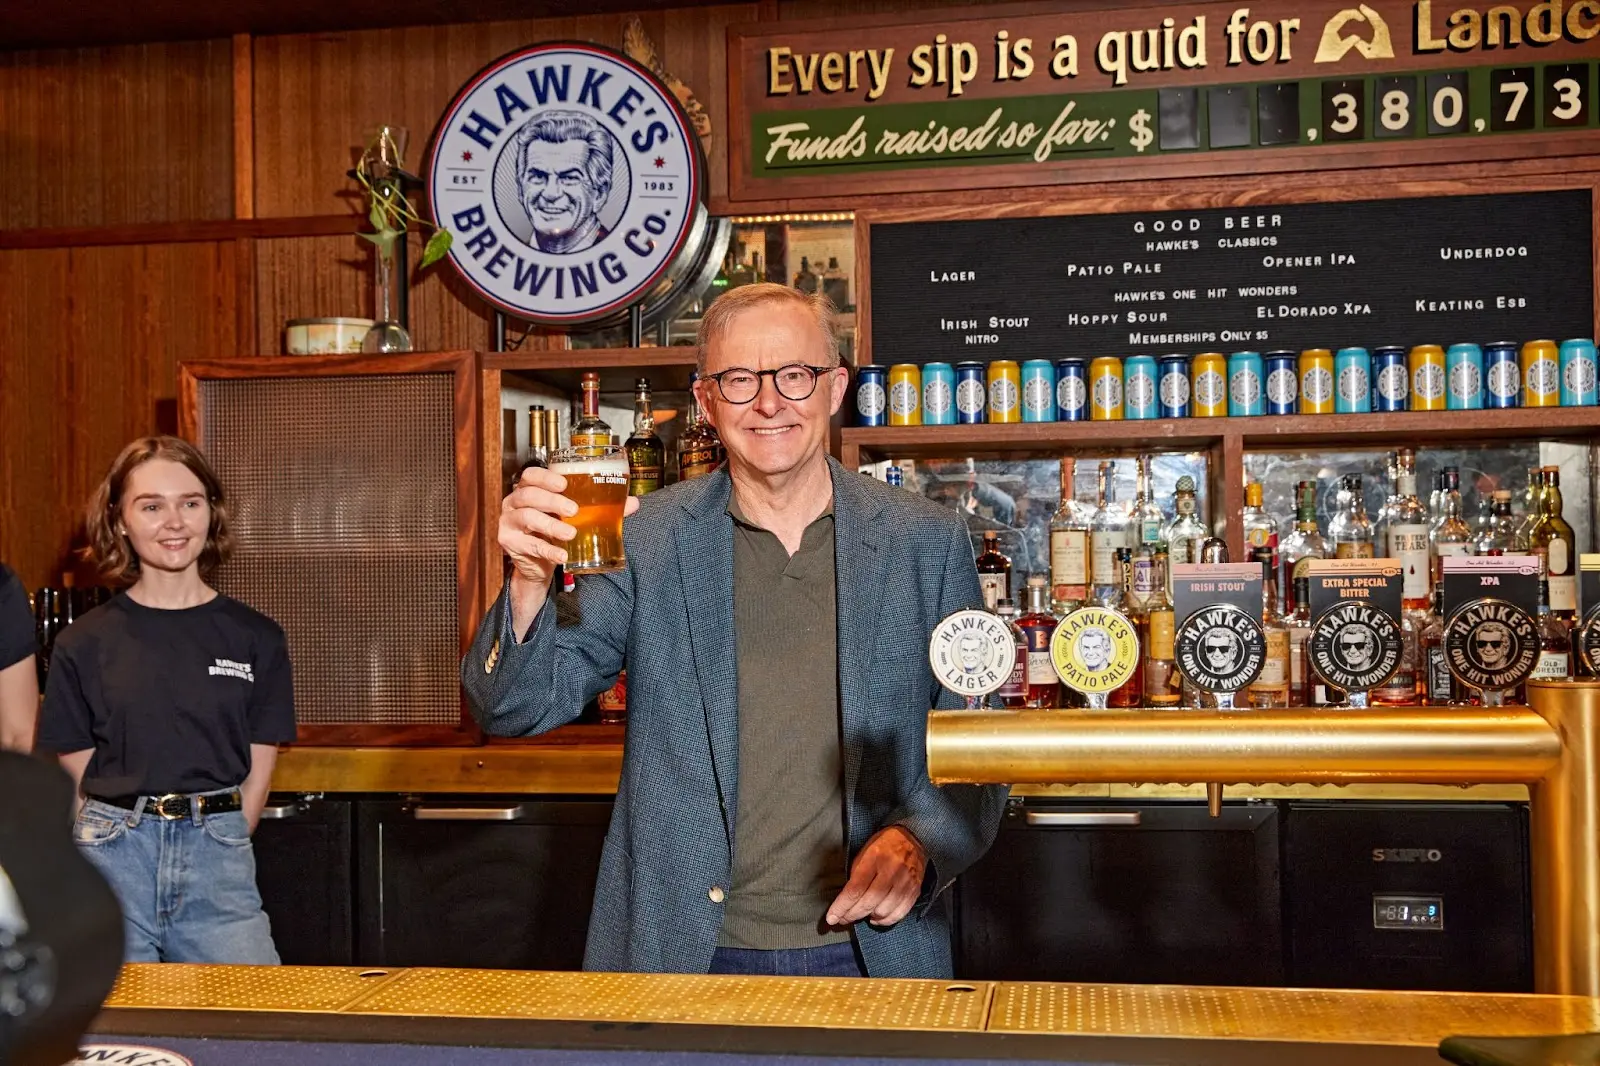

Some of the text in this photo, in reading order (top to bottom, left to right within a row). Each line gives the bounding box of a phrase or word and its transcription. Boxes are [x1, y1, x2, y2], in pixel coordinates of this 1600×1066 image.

[767, 46, 895, 99] Every
[909, 33, 978, 95] sip
[997, 30, 1035, 80] is
[1053, 34, 1079, 77] a
[1098, 15, 1207, 85] quid
[1227, 8, 1300, 64] for
[460, 65, 668, 153] HAWKE'S
[766, 116, 867, 163] Funds
[875, 107, 1003, 155] raised
[998, 118, 1041, 148] so
[1031, 101, 1115, 162] far:
[452, 175, 477, 185] EST
[644, 182, 674, 192] 1983
[1134, 215, 1282, 233] GOOD BEER
[452, 204, 628, 299] BREWING
[1146, 236, 1278, 252] HAWKE'S CLASSICS
[1262, 253, 1356, 268] OPENER IPA
[1440, 247, 1528, 260] UNDERDOG
[930, 270, 976, 283] LAGER
[1067, 262, 1162, 277] PATIO PALE
[1114, 285, 1298, 302] HAWKE'S ONE HIT WONDERS
[1278, 304, 1338, 318] DORADO
[1343, 303, 1372, 315] XPA
[1415, 297, 1527, 312] KEATING ESB
[941, 316, 1030, 330] IRISH STOUT
[1068, 311, 1168, 326] HOPPY SOUR
[965, 334, 999, 344] NITRO
[1129, 332, 1217, 345] MEMBERSHIPS
[1220, 330, 1252, 342] ONLY
[1395, 541, 1427, 551] TEARS
[1190, 582, 1246, 592] IRISH STOUT
[1322, 577, 1388, 588] EXTRA SPECIAL
[1480, 576, 1500, 586] XPA
[1340, 588, 1370, 598] BITTER
[1060, 613, 1128, 640] HAWKE'S
[1184, 610, 1257, 641] HAWKE'S
[1319, 607, 1394, 638] HAWKE'S
[1454, 605, 1532, 636] HAWKE'S
[941, 617, 1005, 644] HAWKE'S
[208, 665, 248, 680] BREWING
[1062, 662, 1097, 687] PATIO
[1101, 661, 1128, 685] PALE
[1182, 653, 1260, 689] ONE HIT WONDER
[1317, 650, 1397, 686] ONE HIT WONDER
[1451, 648, 1470, 672] ONE
[1467, 668, 1490, 684] HIT
[1491, 649, 1534, 685] WONDER
[1536, 666, 1566, 674] ORESTER
[946, 668, 998, 688] LAGER
